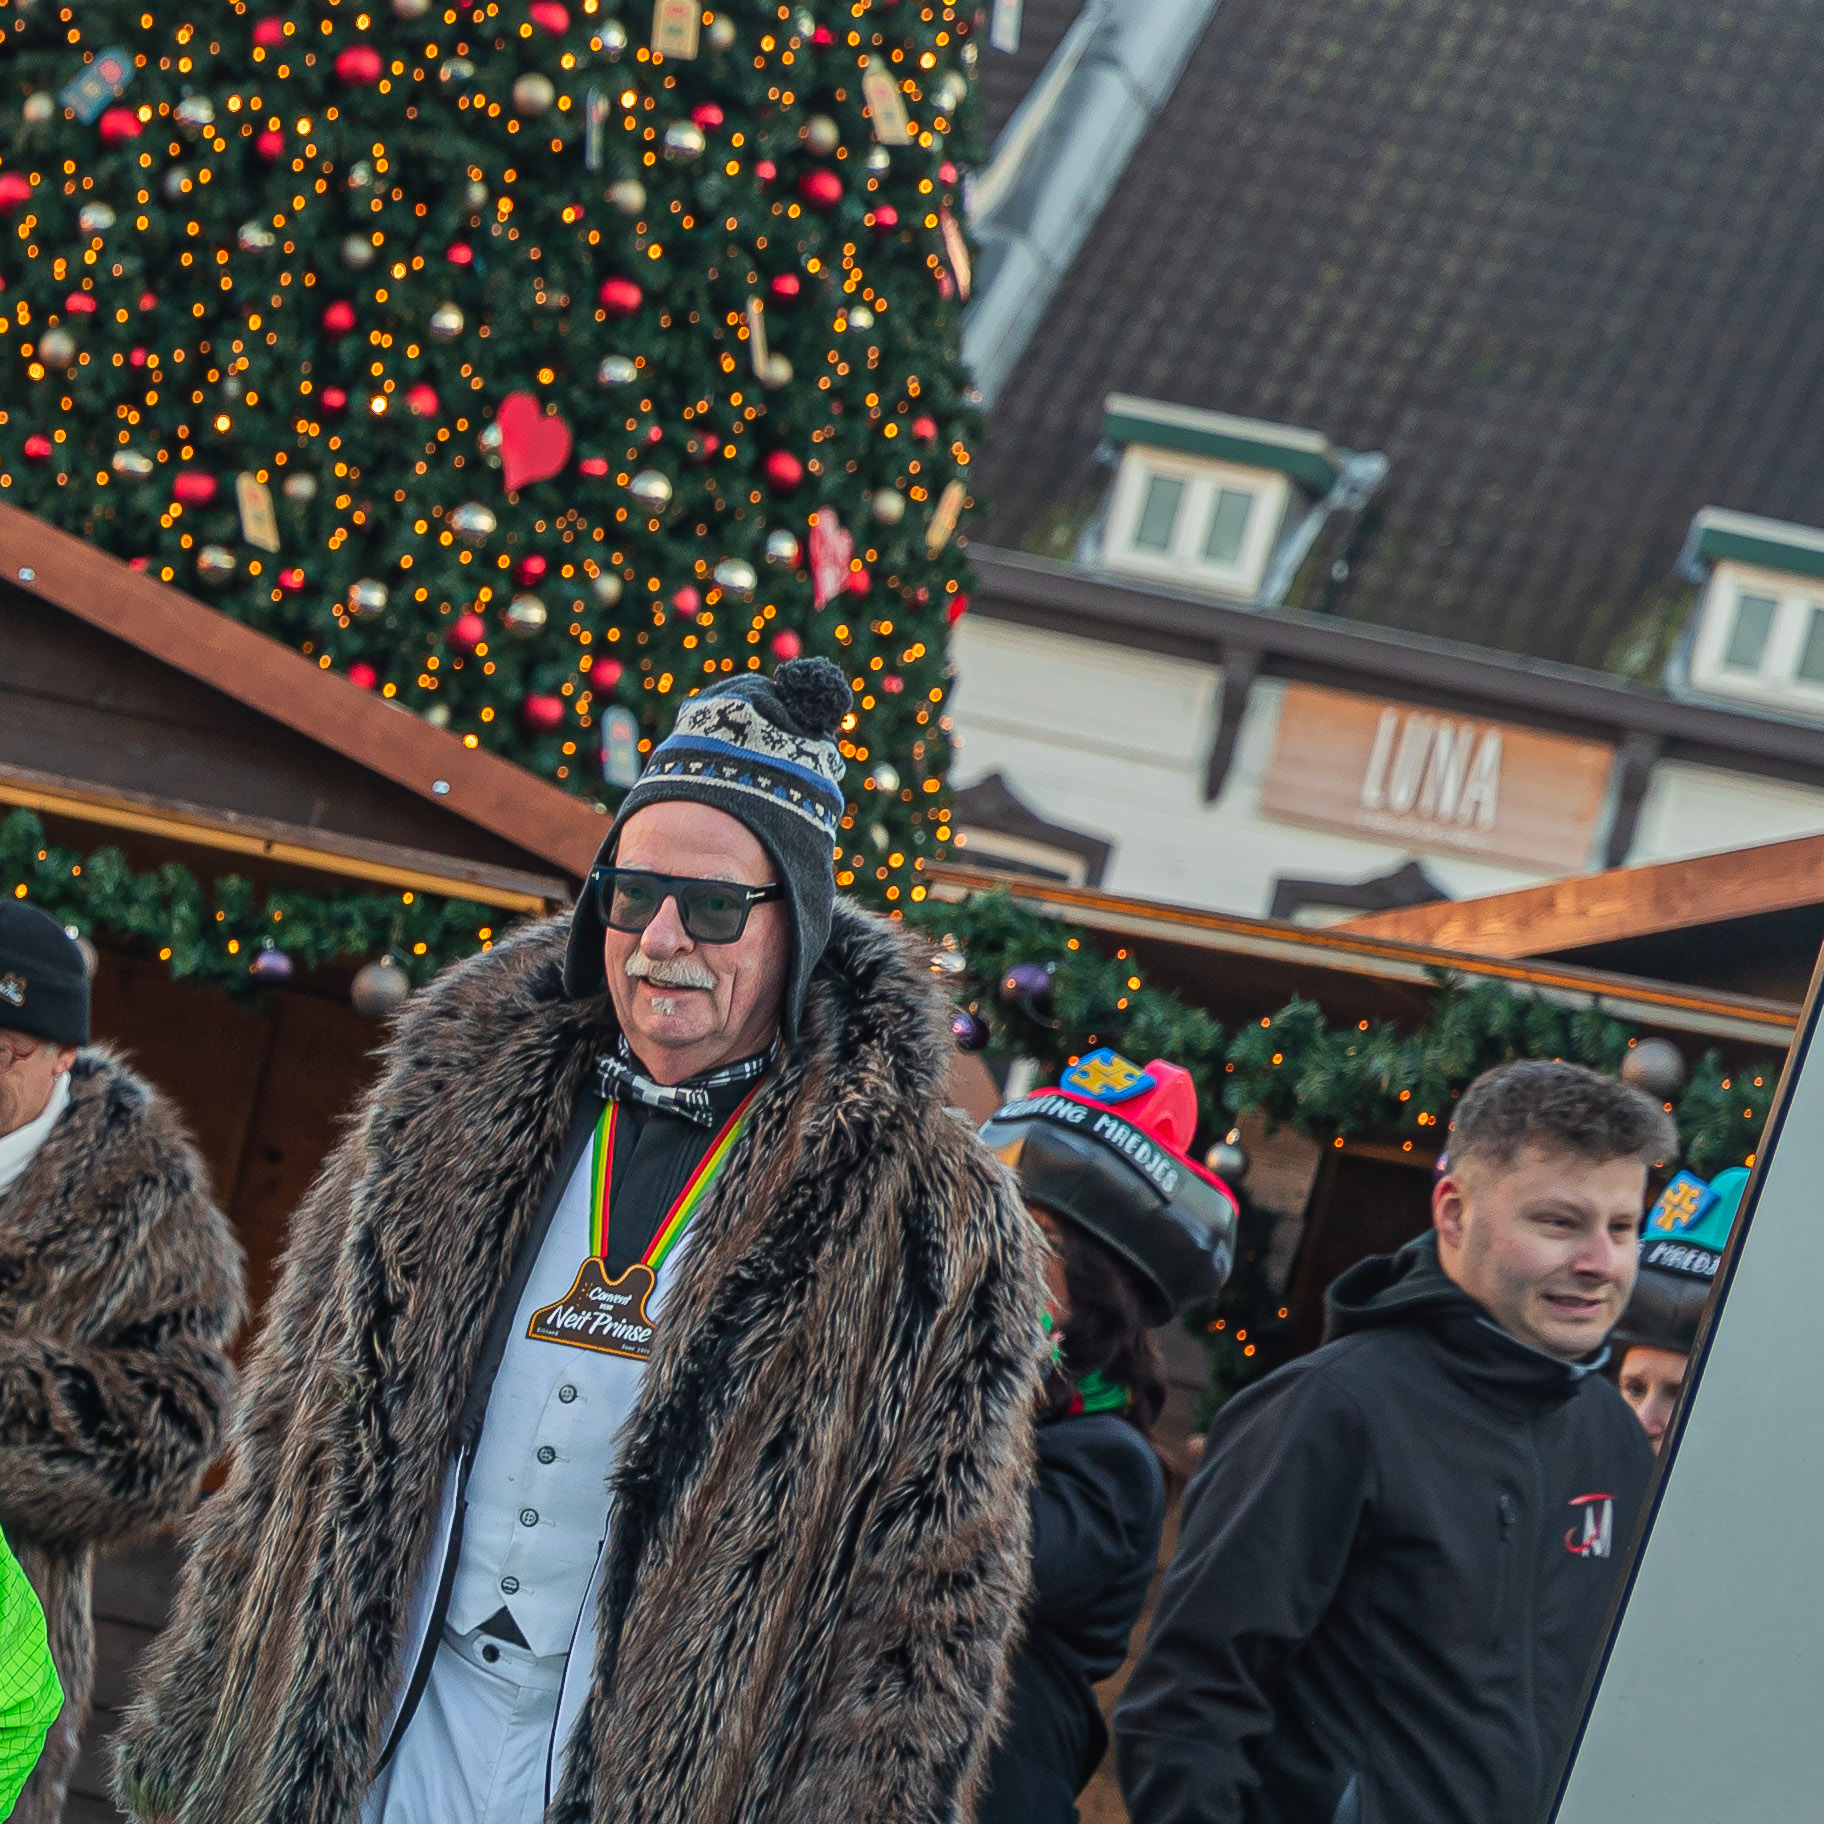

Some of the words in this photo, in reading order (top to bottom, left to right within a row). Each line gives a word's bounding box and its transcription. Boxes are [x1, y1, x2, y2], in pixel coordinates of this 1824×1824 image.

[1360, 706, 1503, 832] LUNA
[1648, 1241, 1722, 1275] MAEDJ
[588, 1311, 653, 1343] Prinse
